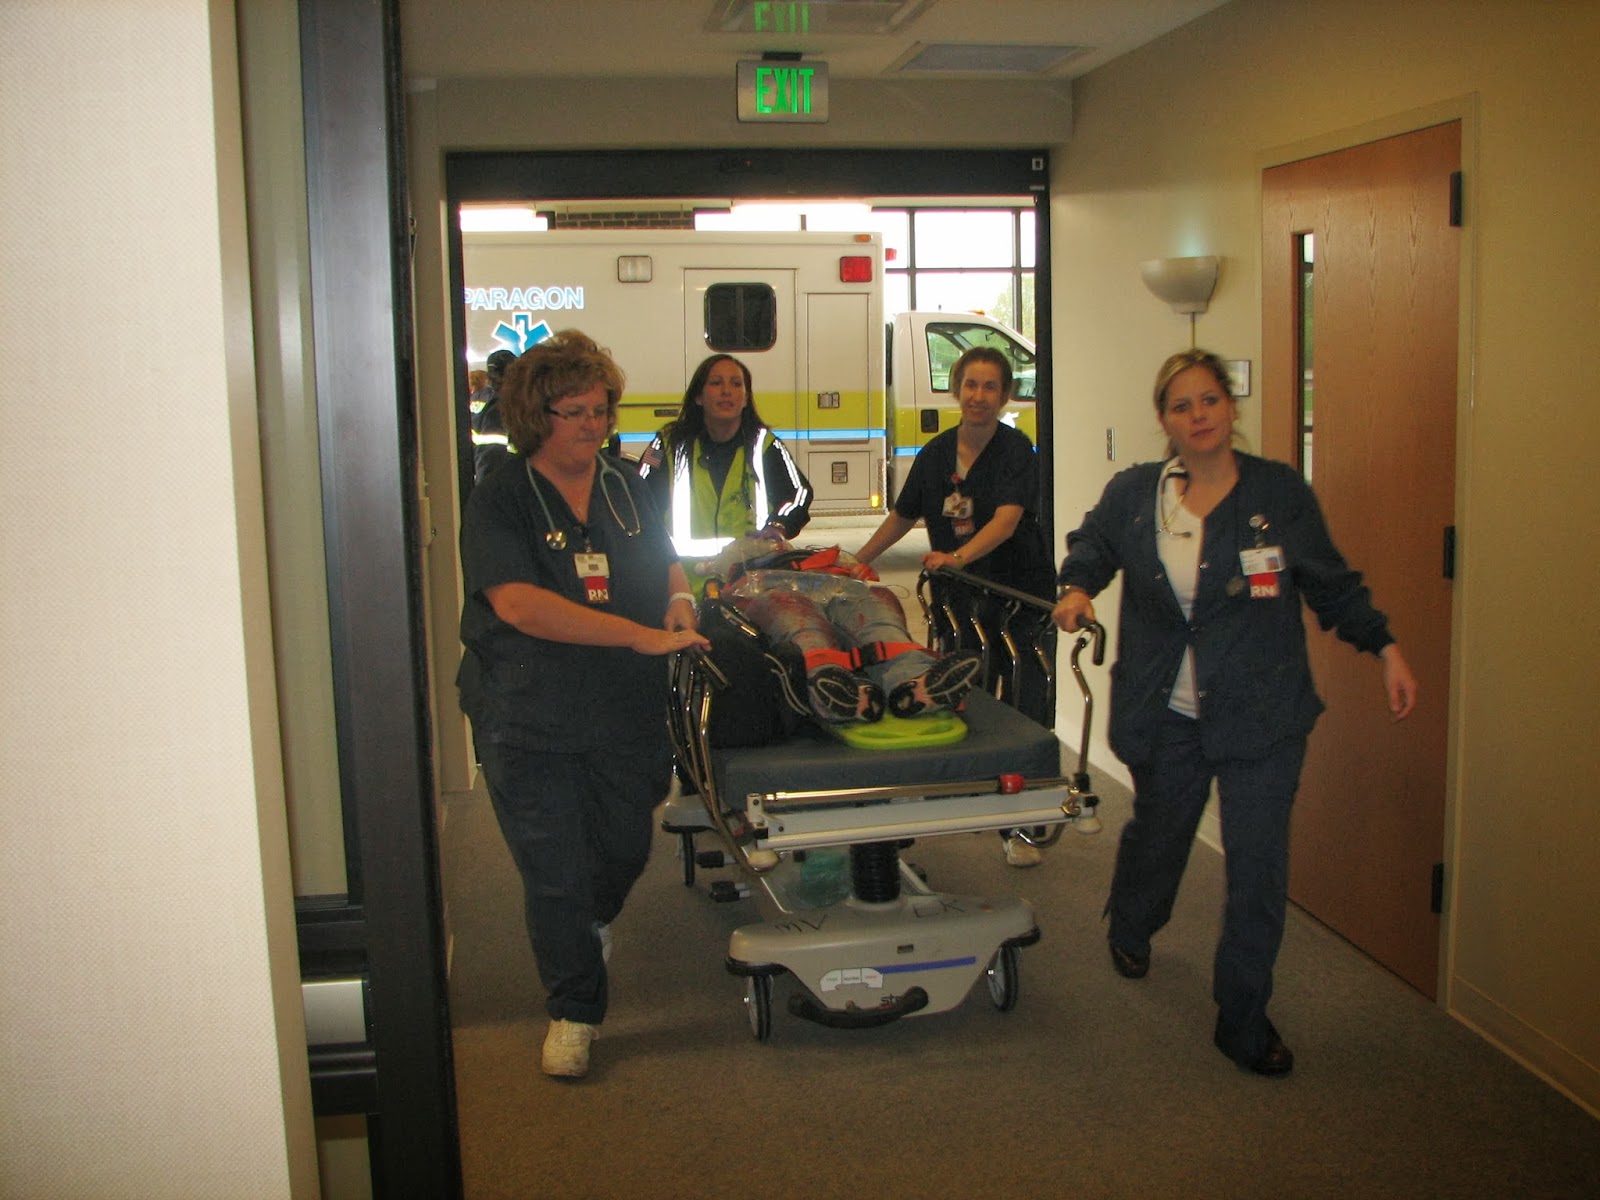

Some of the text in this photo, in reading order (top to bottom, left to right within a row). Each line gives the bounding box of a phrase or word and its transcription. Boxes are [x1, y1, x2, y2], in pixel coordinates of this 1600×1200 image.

[756, 67, 815, 113] EXIT
[464, 286, 584, 310] PARAGON
[587, 589, 609, 600] RN
[1250, 584, 1278, 597] RN
